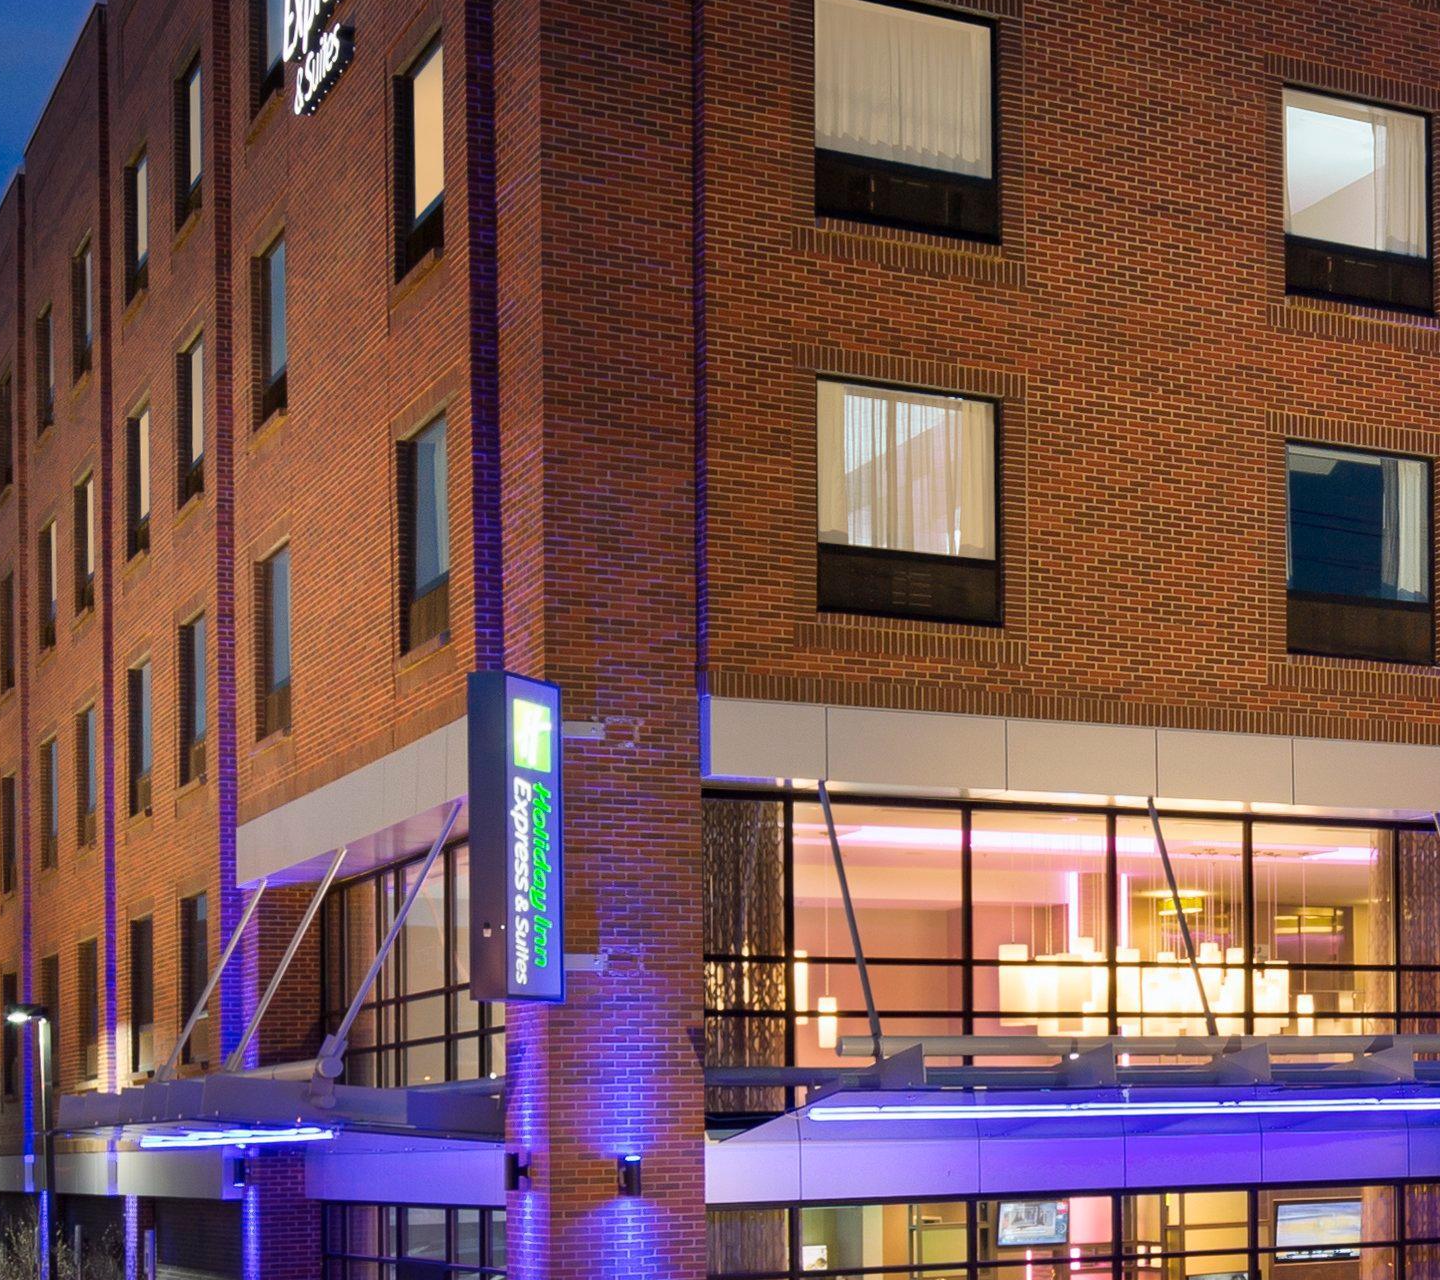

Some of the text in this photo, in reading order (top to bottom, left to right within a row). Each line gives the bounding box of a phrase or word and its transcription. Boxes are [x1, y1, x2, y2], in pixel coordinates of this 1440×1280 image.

[293, 22, 341, 116] & Suites
[511, 776, 532, 986] Express & Suites
[528, 781, 552, 969] Holiday Inn
